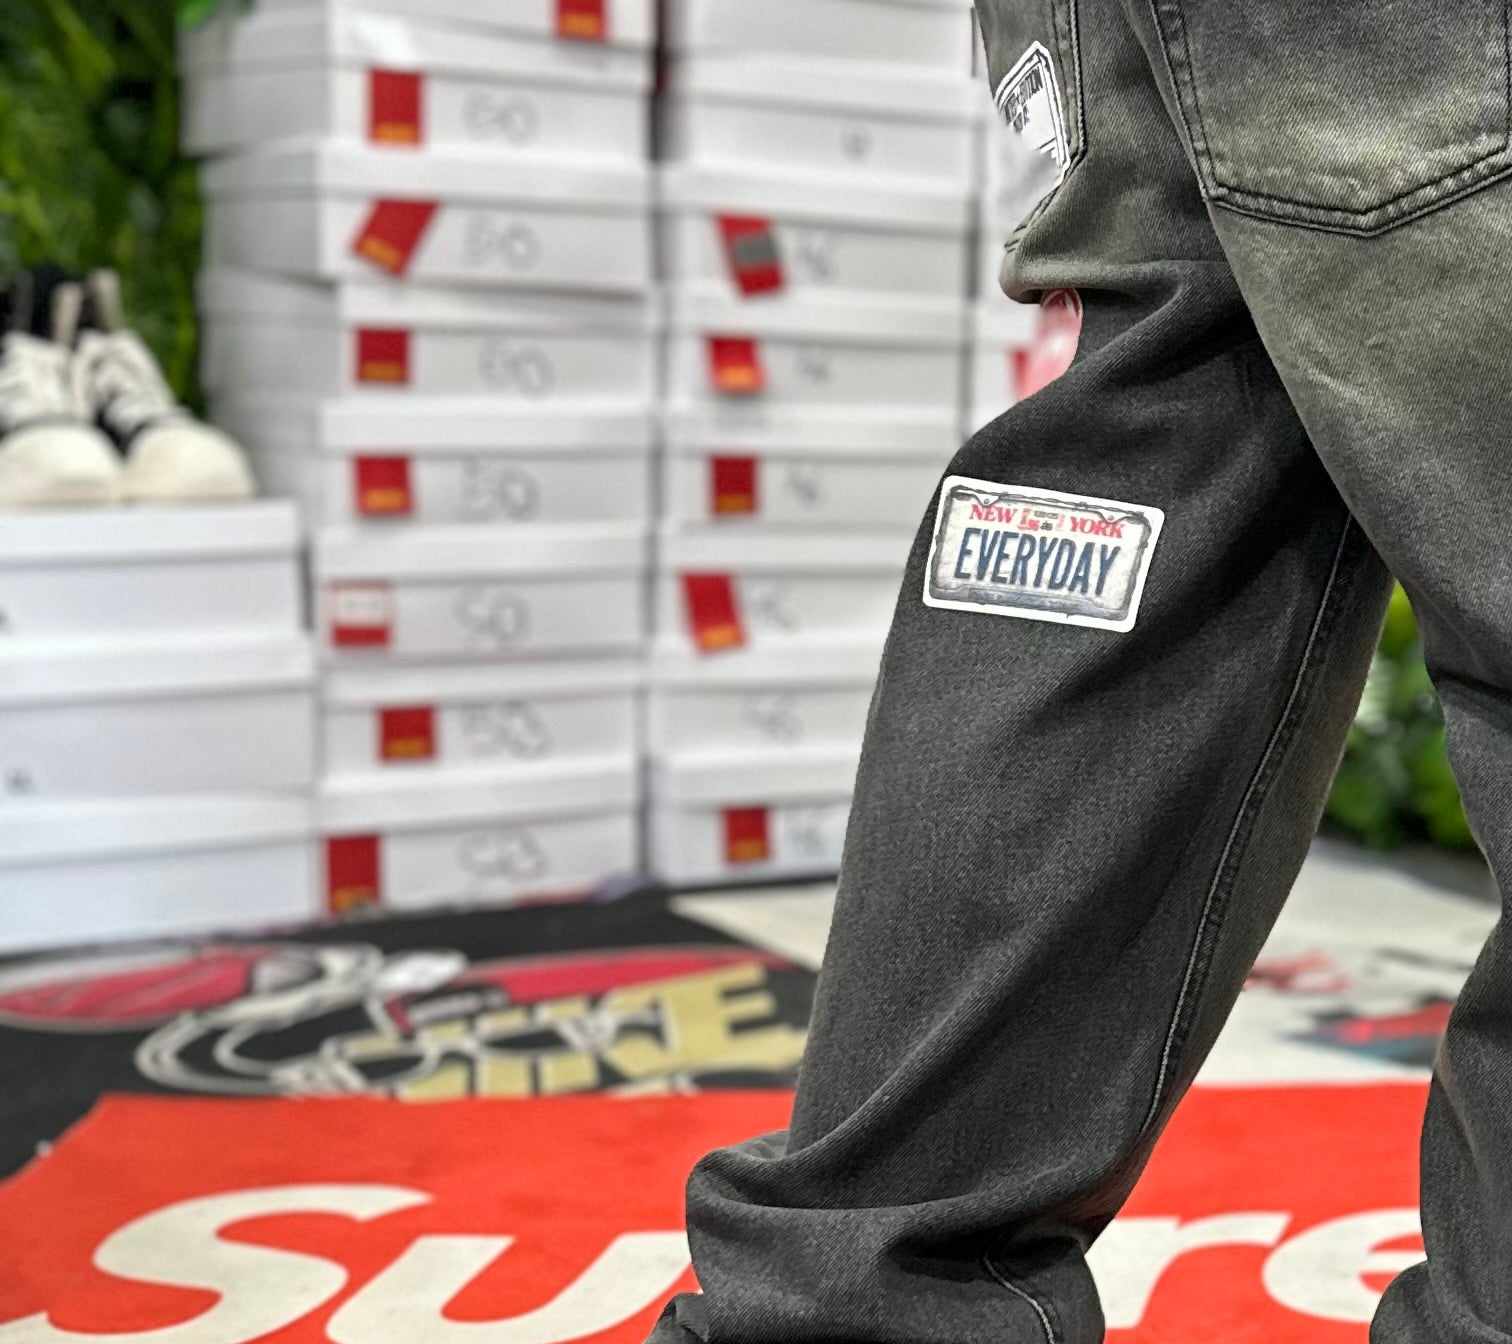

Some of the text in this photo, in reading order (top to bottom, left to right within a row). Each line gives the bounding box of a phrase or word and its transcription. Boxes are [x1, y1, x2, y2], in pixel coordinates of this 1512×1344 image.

[969, 503, 1018, 525] NEW
[1070, 515, 1126, 539] YORK
[954, 527, 1121, 596] EVERYDAY
